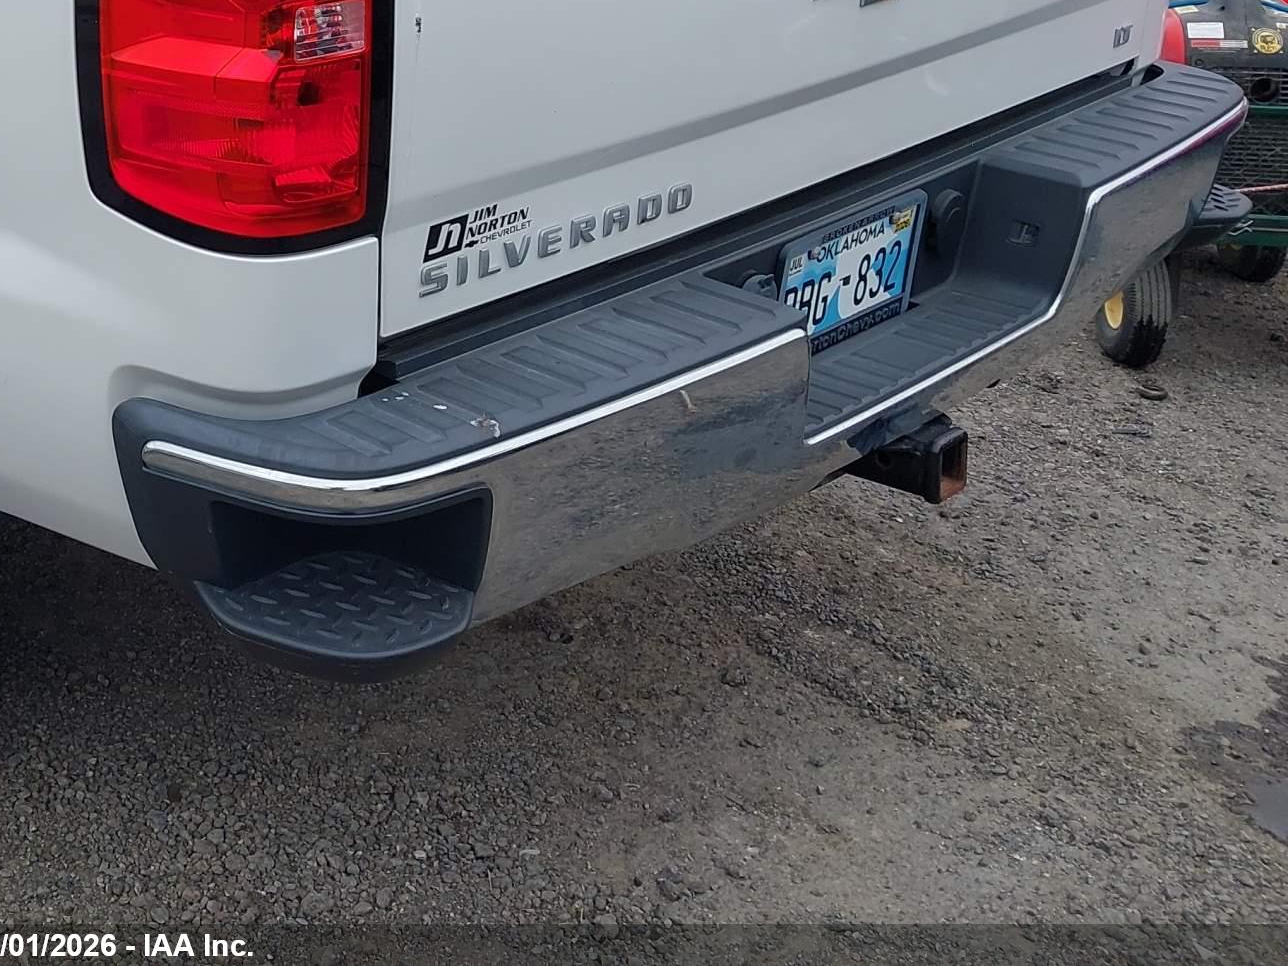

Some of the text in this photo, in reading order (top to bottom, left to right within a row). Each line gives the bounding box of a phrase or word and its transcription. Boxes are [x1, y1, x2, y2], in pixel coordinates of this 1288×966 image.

[466, 207, 530, 240] NORTON
[469, 203, 498, 225] JIM
[418, 182, 694, 298] SILVERADO
[480, 220, 533, 244] CHEVROLET
[816, 221, 885, 262] OKLAHOMA
[789, 256, 803, 272] JUL
